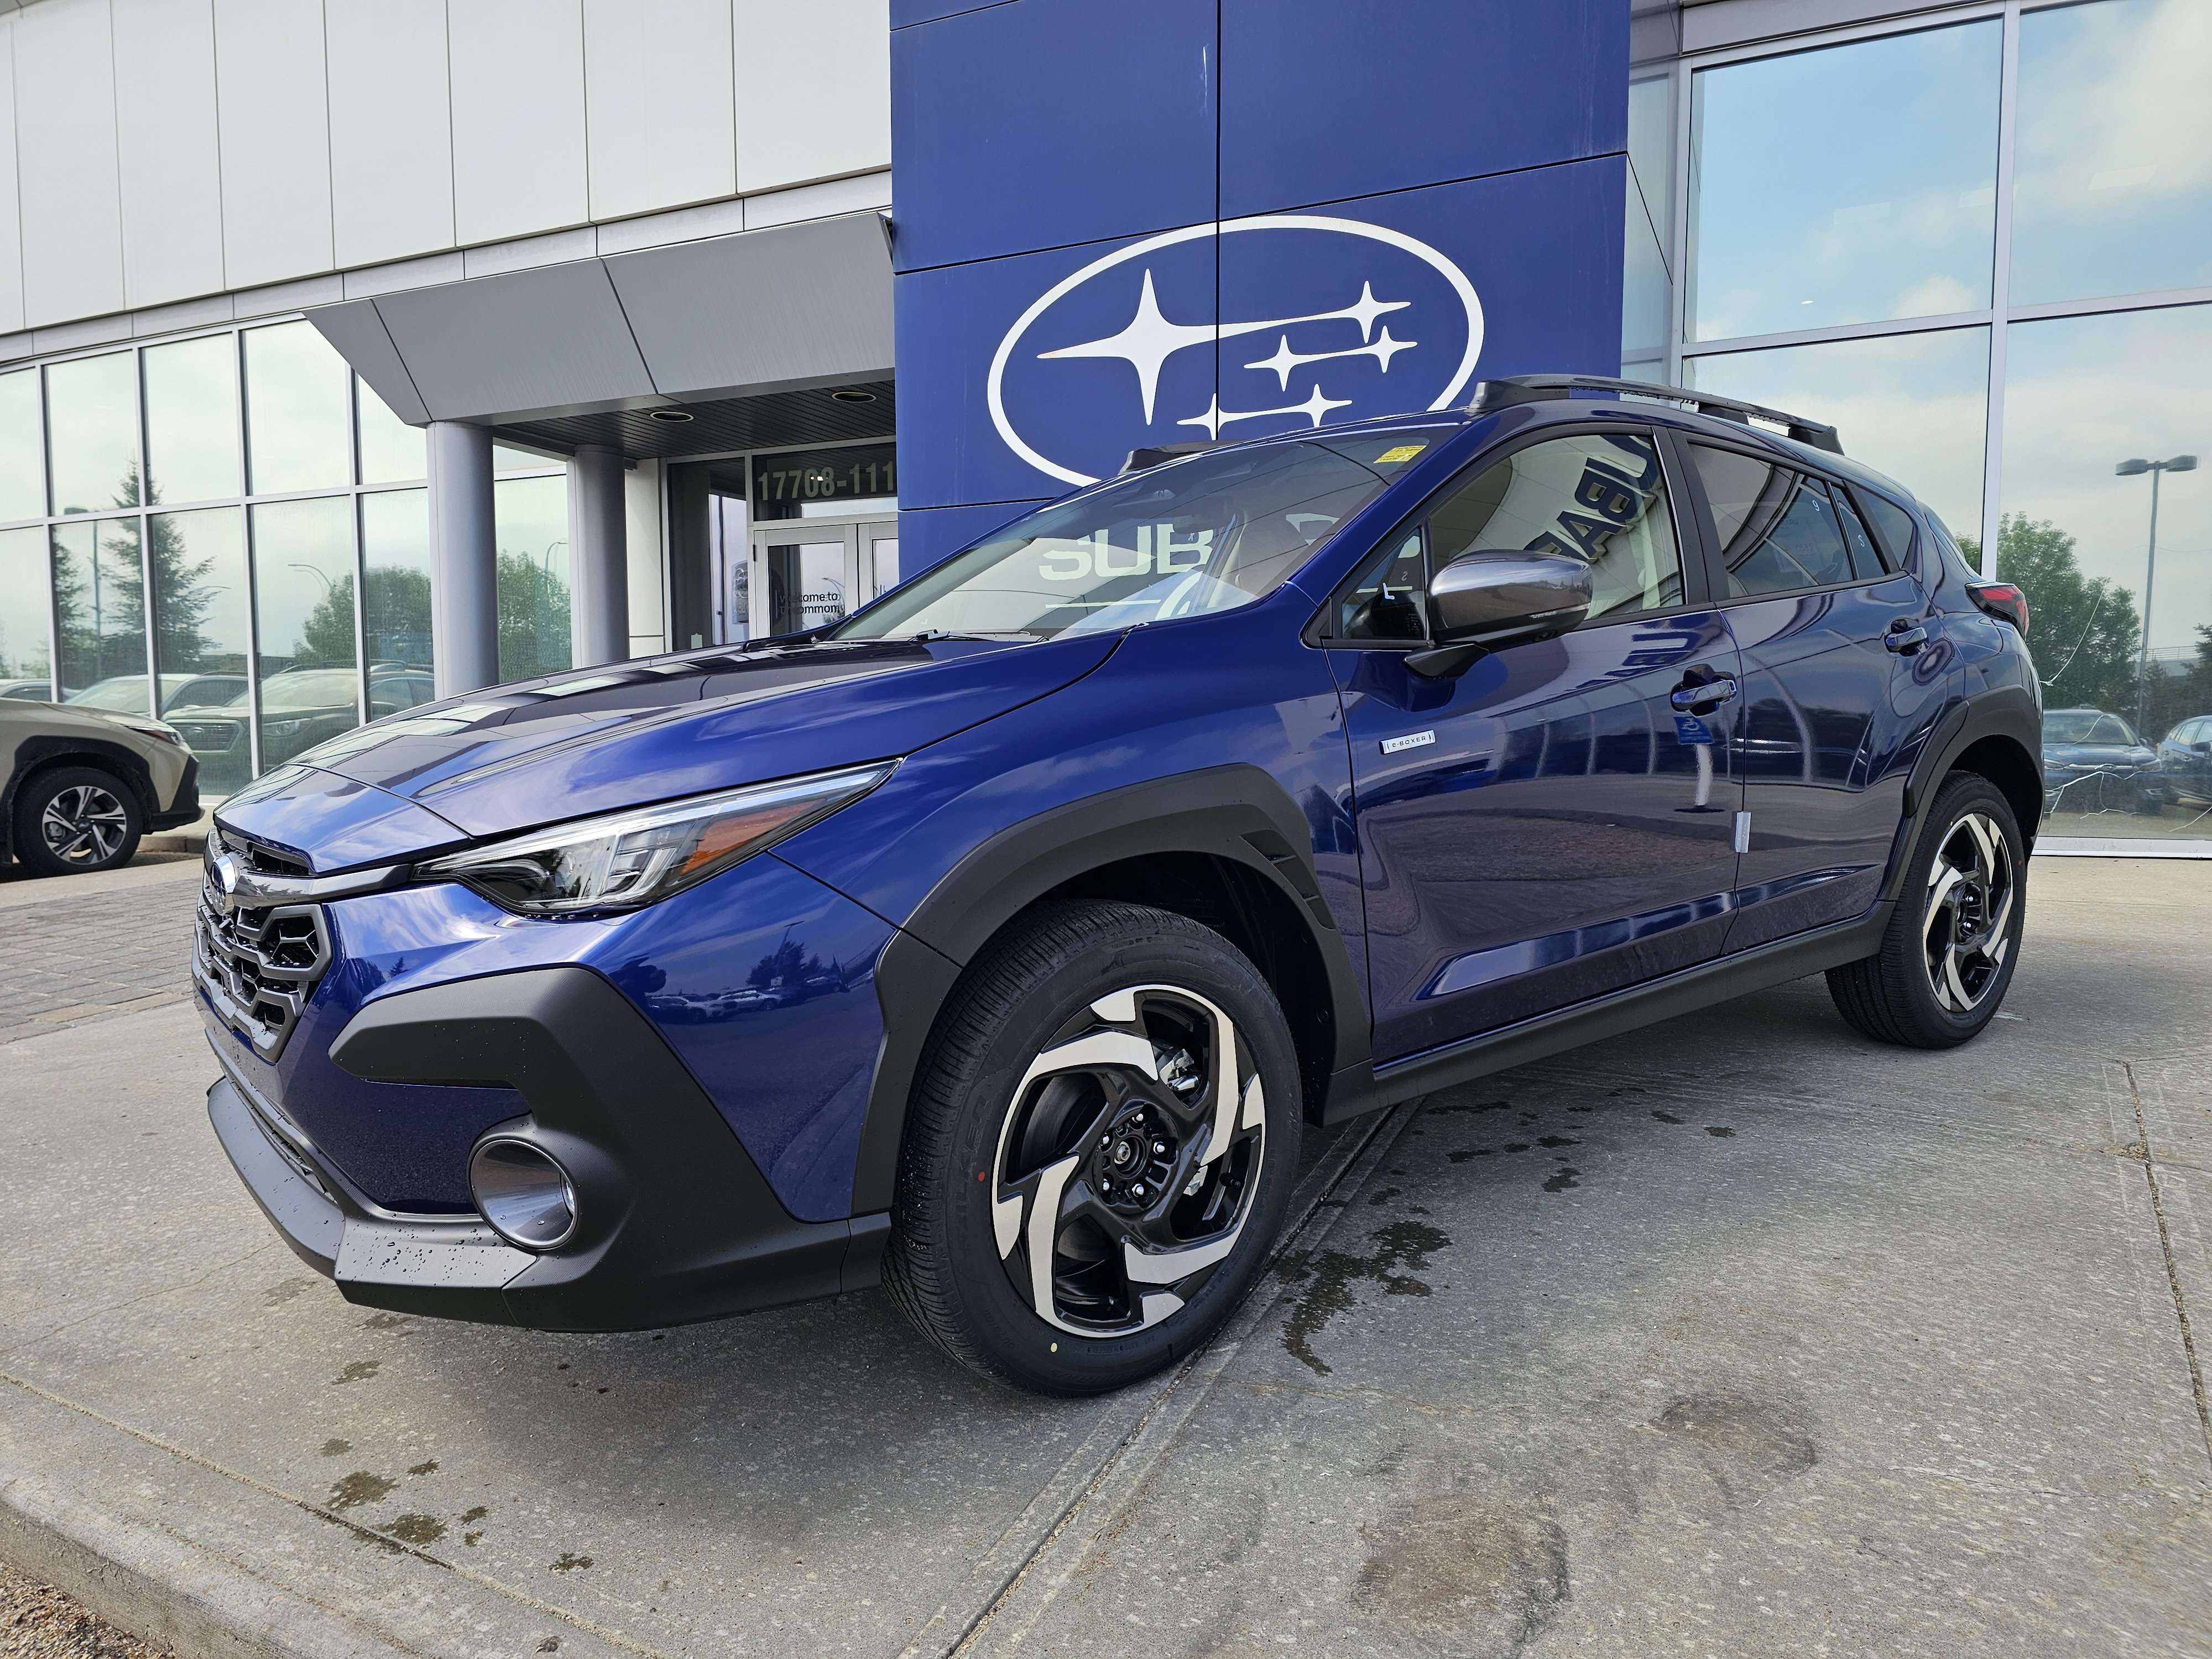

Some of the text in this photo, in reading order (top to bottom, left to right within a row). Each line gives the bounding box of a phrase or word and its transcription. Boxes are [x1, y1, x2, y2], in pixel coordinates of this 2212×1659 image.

[758, 461, 894, 500] 17708-111
[1039, 524, 1214, 581] SUB
[827, 591, 838, 601] to
